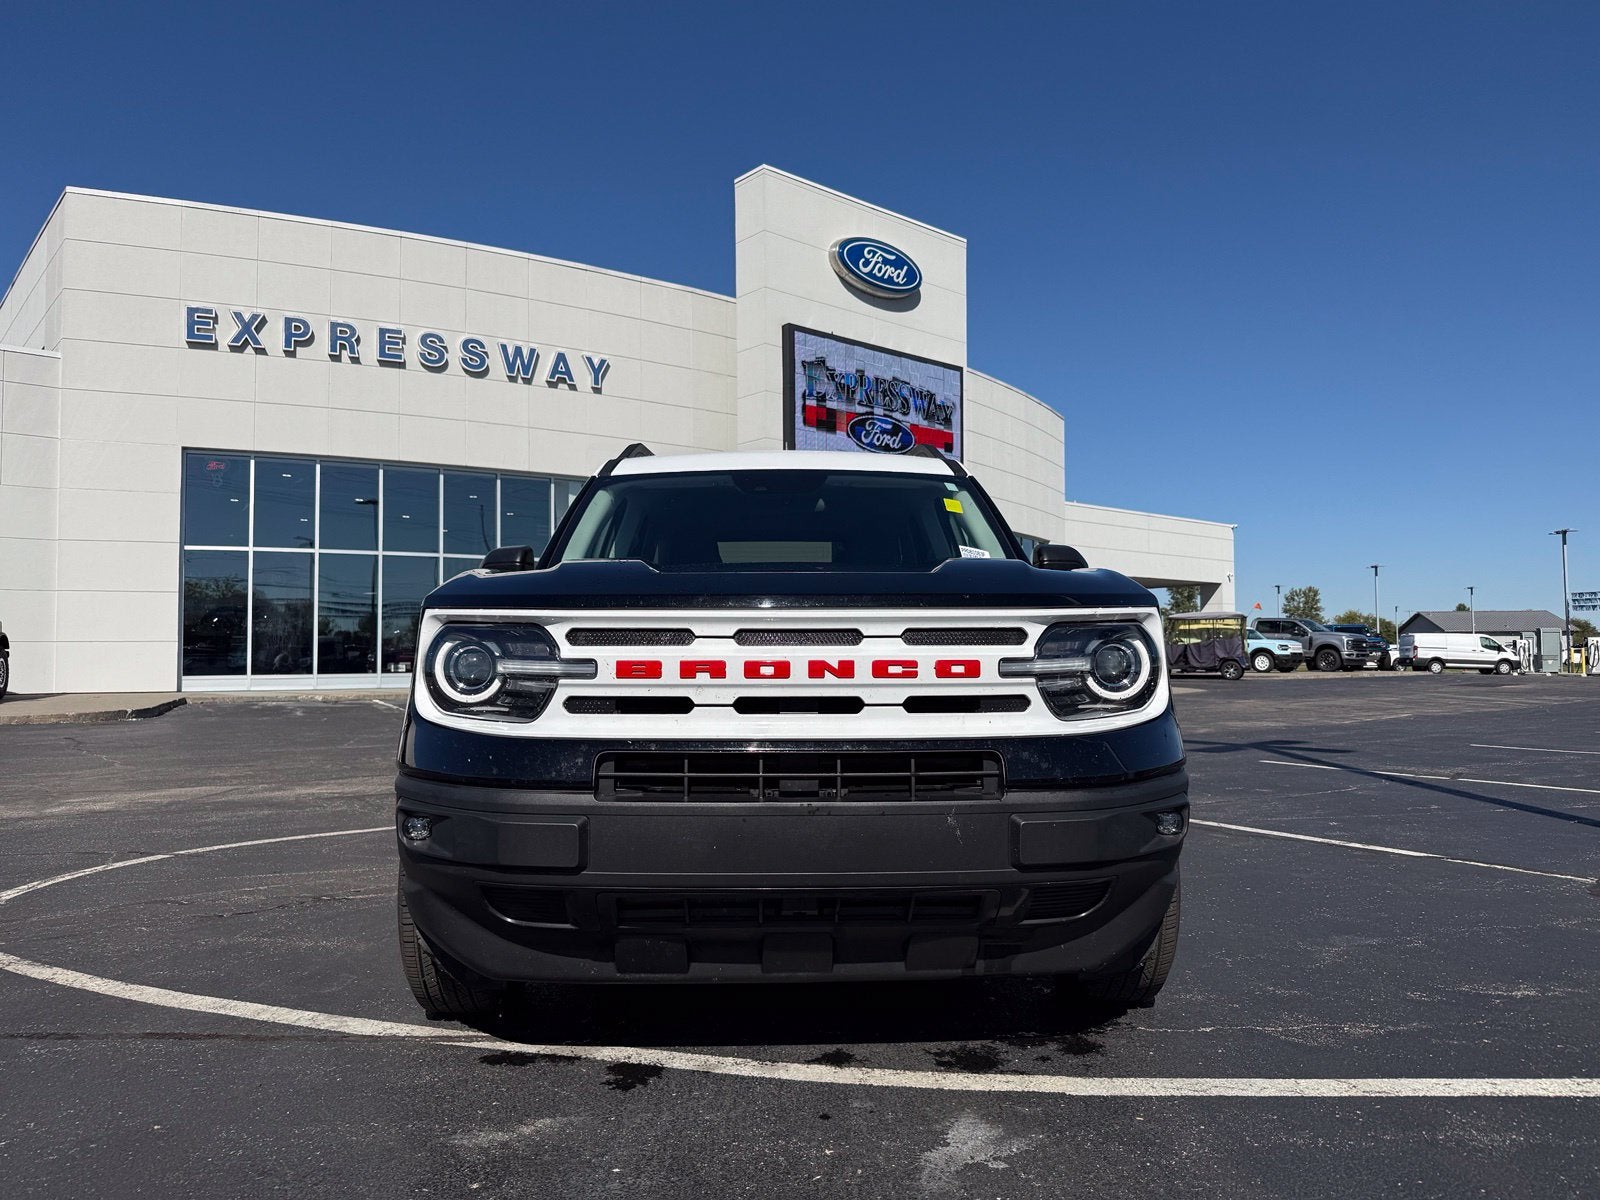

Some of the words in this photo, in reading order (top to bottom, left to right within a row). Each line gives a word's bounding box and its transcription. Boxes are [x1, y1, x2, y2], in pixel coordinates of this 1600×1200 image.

[858, 246, 908, 284] Ford
[185, 305, 611, 391] EXPRESSWAY
[861, 421, 902, 448] Ford
[615, 660, 981, 679] BRONCO
